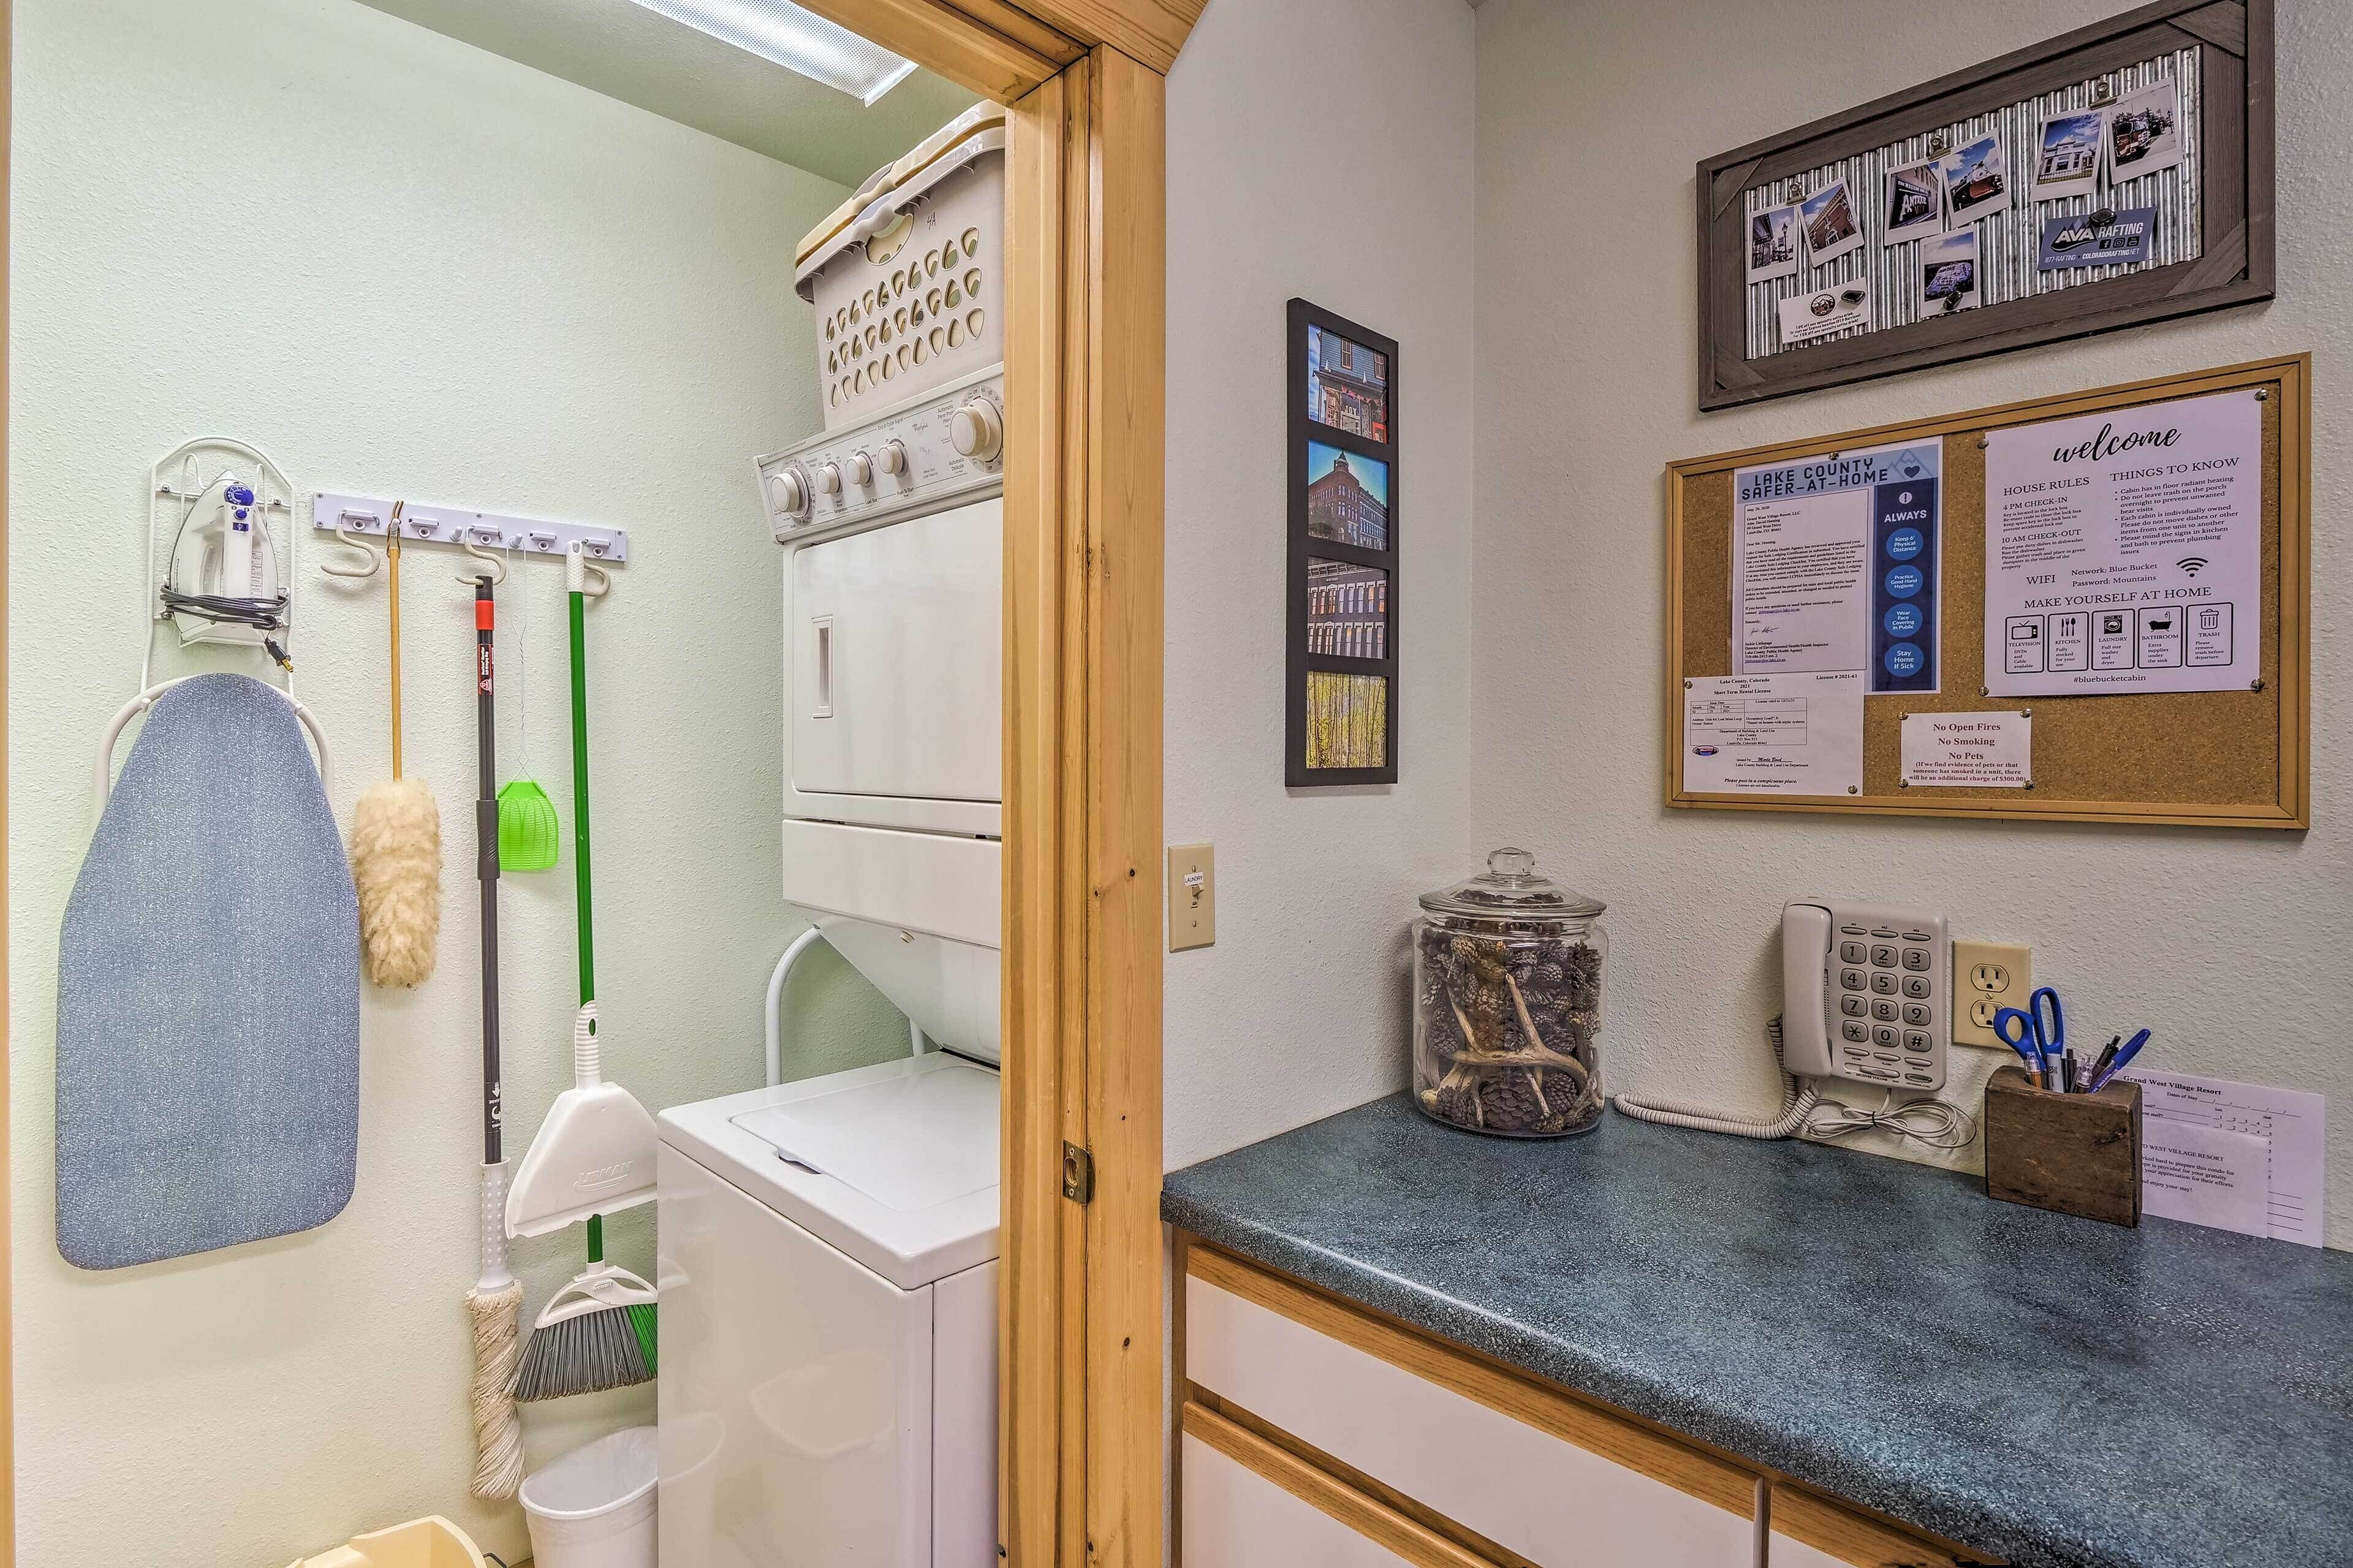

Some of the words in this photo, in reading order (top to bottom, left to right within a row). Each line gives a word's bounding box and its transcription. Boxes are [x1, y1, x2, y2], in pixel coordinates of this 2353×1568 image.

[2055, 228, 2094, 243] AVA
[2098, 222, 2143, 238] RAFTING
[2045, 254, 2076, 263] 877-RAFTING
[2082, 248, 2140, 259] COLORADORAFTING.NET
[2053, 423, 2181, 463] welcome
[1754, 469, 1794, 487] LAKE
[1804, 458, 1873, 479] COUNTY
[2110, 468, 2163, 482] THINGS
[2166, 464, 2188, 475] TO
[2192, 458, 2239, 471] KNOW
[1742, 469, 1888, 501] SAFER-AT-HOME
[2004, 482, 2045, 496] HOUSE
[2049, 477, 2089, 490] RULES
[2181, 479, 2205, 487] radiant
[2207, 475, 2234, 485] heating
[2206, 483, 2226, 493] porch
[2024, 496, 2067, 508] CHECK-IN
[1884, 510, 1927, 522] ALWAYS
[2164, 507, 2206, 518] individually
[2027, 528, 2081, 540] CHECK-OUT
[2071, 567, 2107, 575] Network:
[2129, 563, 2157, 572] Bucket
[2026, 575, 2055, 585] WIFI
[2072, 578, 2110, 587] Password:
[2113, 575, 2156, 584] Mountains
[2024, 597, 2061, 608] MAKE
[2064, 592, 2137, 605] YOURSELF
[2140, 590, 2161, 600] AT
[2164, 587, 2211, 599] HOME
[2074, 673, 2146, 683] #bluebucketcabin
[1949, 723, 1973, 732] Open
[1953, 738, 1995, 746] Smoking
[1849, 945, 1855, 956] 1
[1879, 949, 1889, 961] 2
[1911, 952, 1921, 964] 3
[1847, 973, 1857, 984] 4
[1879, 976, 1889, 988] 5
[1911, 980, 1922, 992] 6
[1849, 999, 1859, 1010] 7
[1879, 1004, 1889, 1015] 8
[1912, 1008, 1922, 1019] 9
[2123, 1075, 2146, 1084] Grand
[2169, 1081, 2194, 1092] Village
[2196, 1086, 2221, 1095] Resort
[2168, 1148, 2196, 1157] VILLAGE
[2197, 1153, 2224, 1162] RESORT
[2179, 1184, 2192, 1193] stay!
